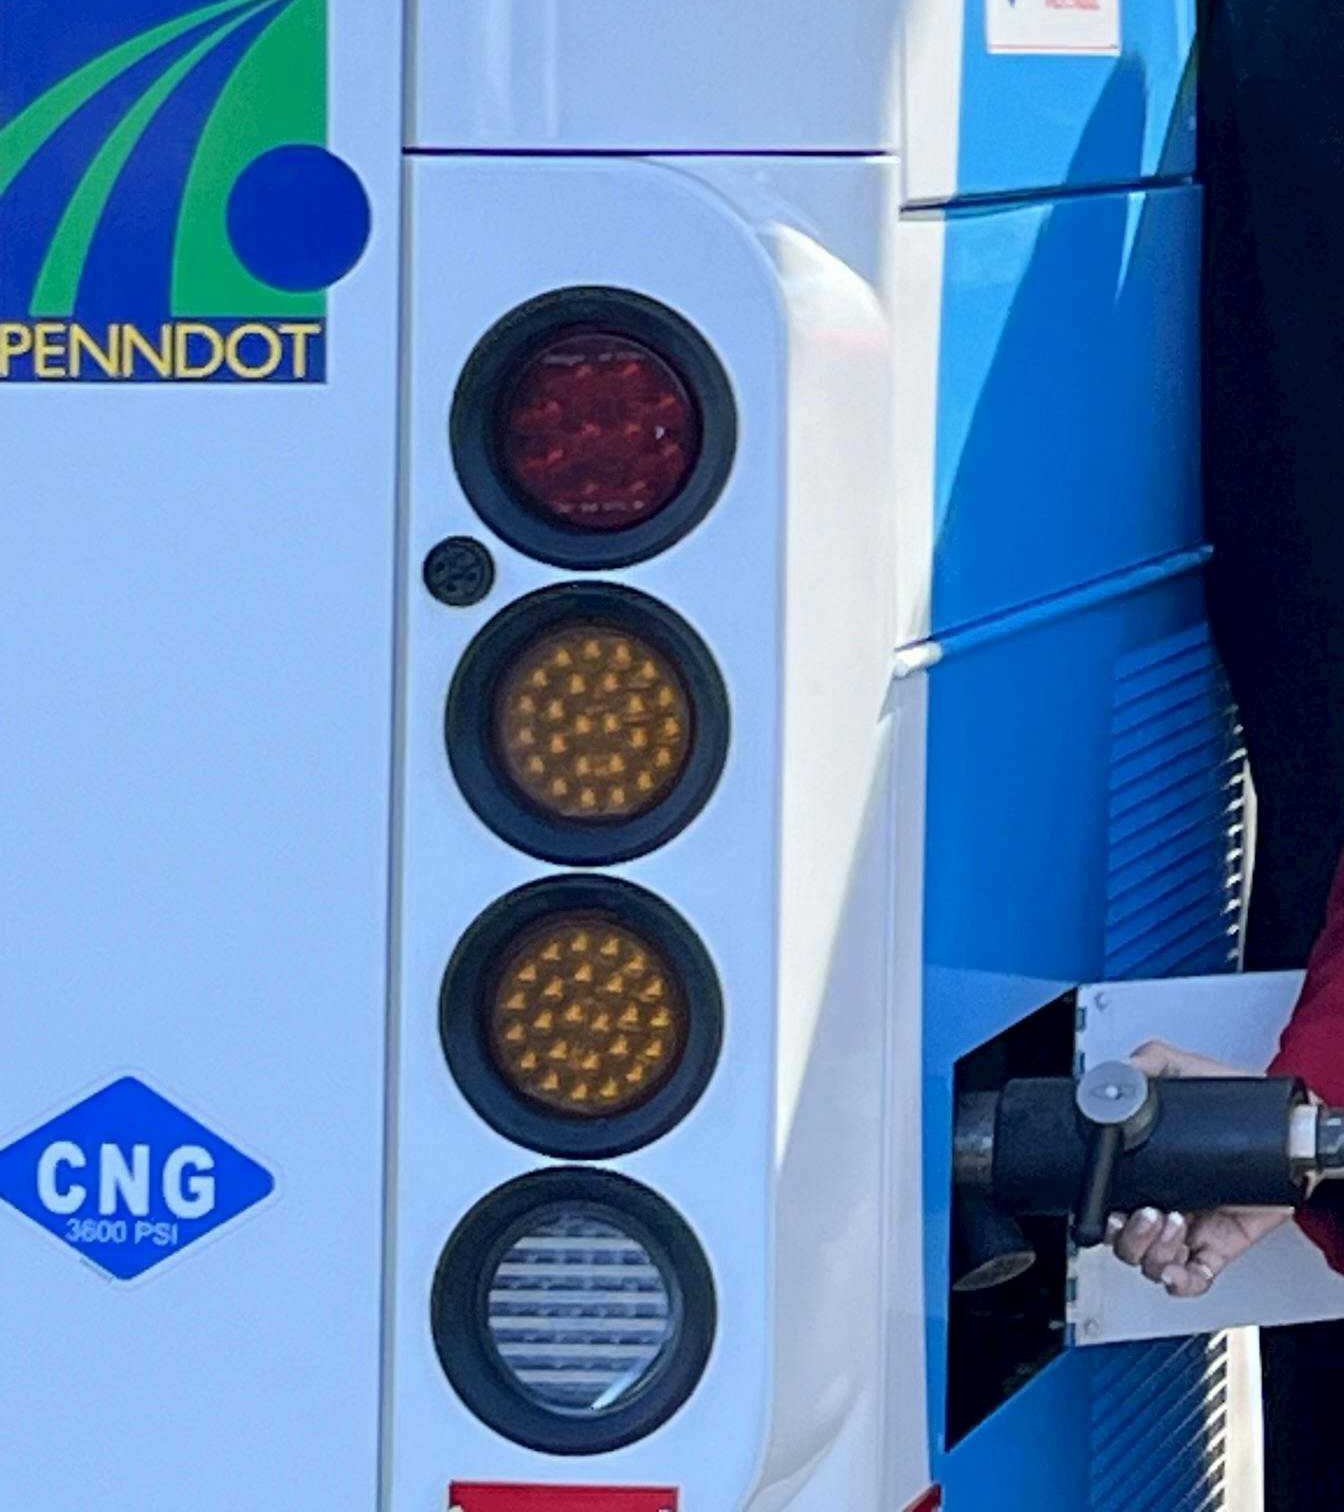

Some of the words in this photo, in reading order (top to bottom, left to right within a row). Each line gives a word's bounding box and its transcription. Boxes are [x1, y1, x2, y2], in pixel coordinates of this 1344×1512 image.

[0, 323, 321, 378] PENNDOT
[37, 1140, 215, 1219] CNG
[65, 1217, 127, 1244] 3600
[134, 1219, 178, 1247] PSI
